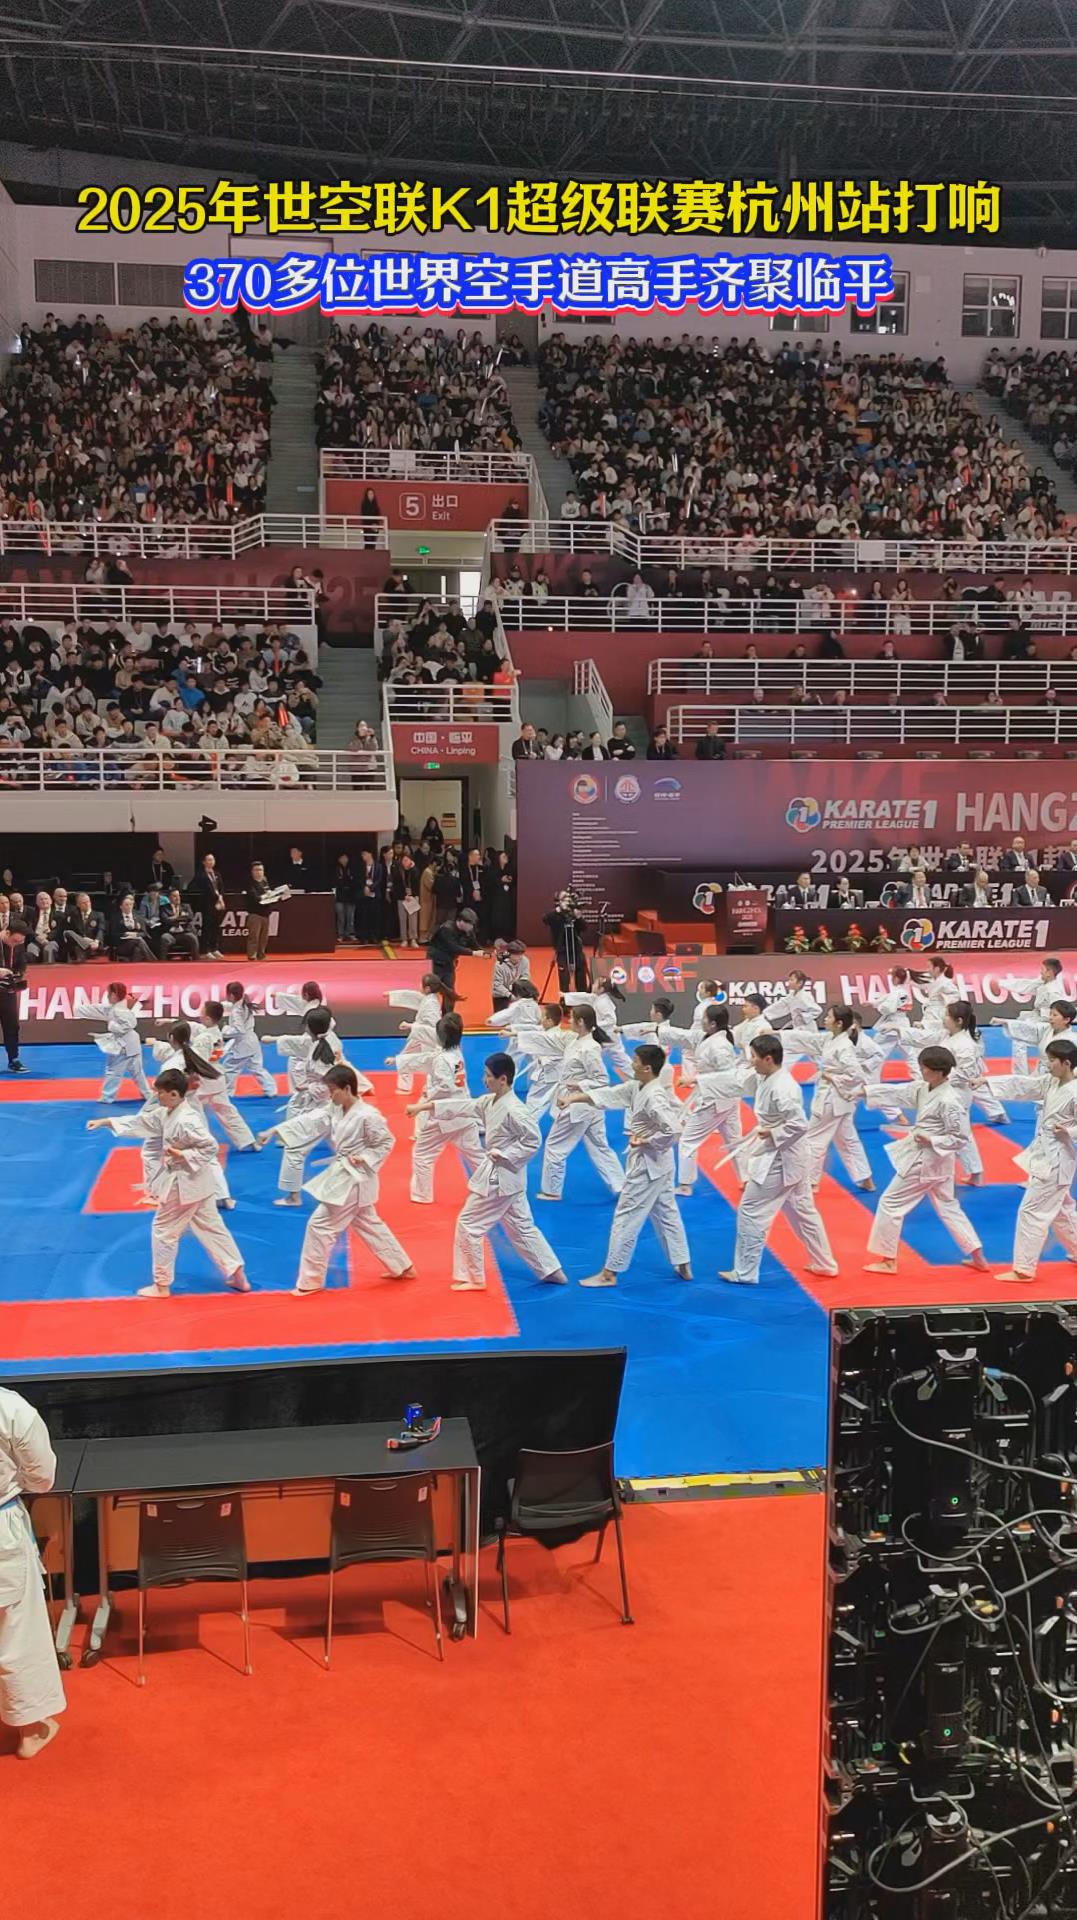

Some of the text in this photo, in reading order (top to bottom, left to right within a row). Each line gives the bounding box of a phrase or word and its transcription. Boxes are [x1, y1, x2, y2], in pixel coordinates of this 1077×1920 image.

[406, 496, 420, 516] 5
[432, 494, 458, 508] 出口
[432, 511, 451, 521] Exit
[411, 746, 476, 756] CHINA Linping
[822, 819, 919, 829] PREMIER LEAGUE
[936, 938, 1032, 949] PREMIER LEAGUE
